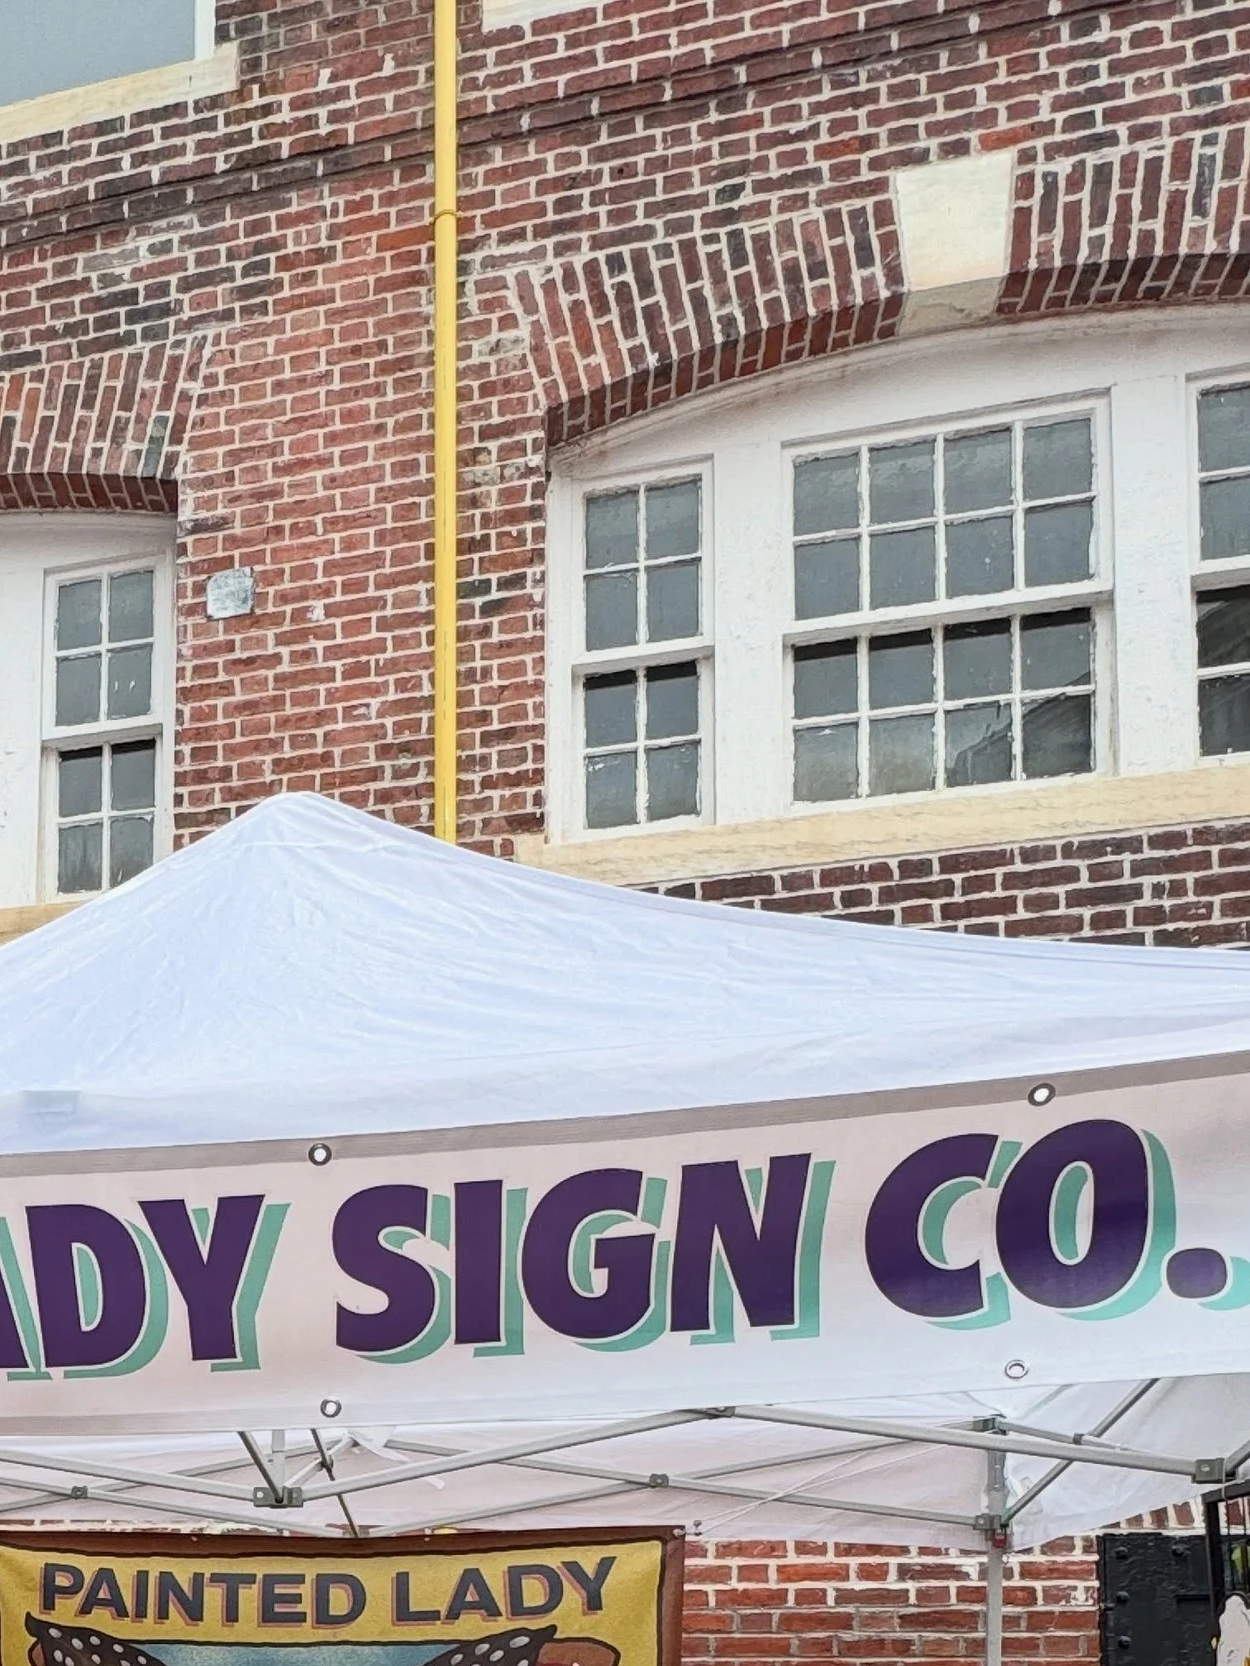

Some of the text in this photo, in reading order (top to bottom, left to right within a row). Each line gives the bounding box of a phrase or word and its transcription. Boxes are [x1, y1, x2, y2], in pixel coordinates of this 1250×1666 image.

[332, 1152, 834, 1364] SIGN
[863, 1118, 1250, 1329] CO.
[39, 1556, 617, 1628] PAINTED LADY
